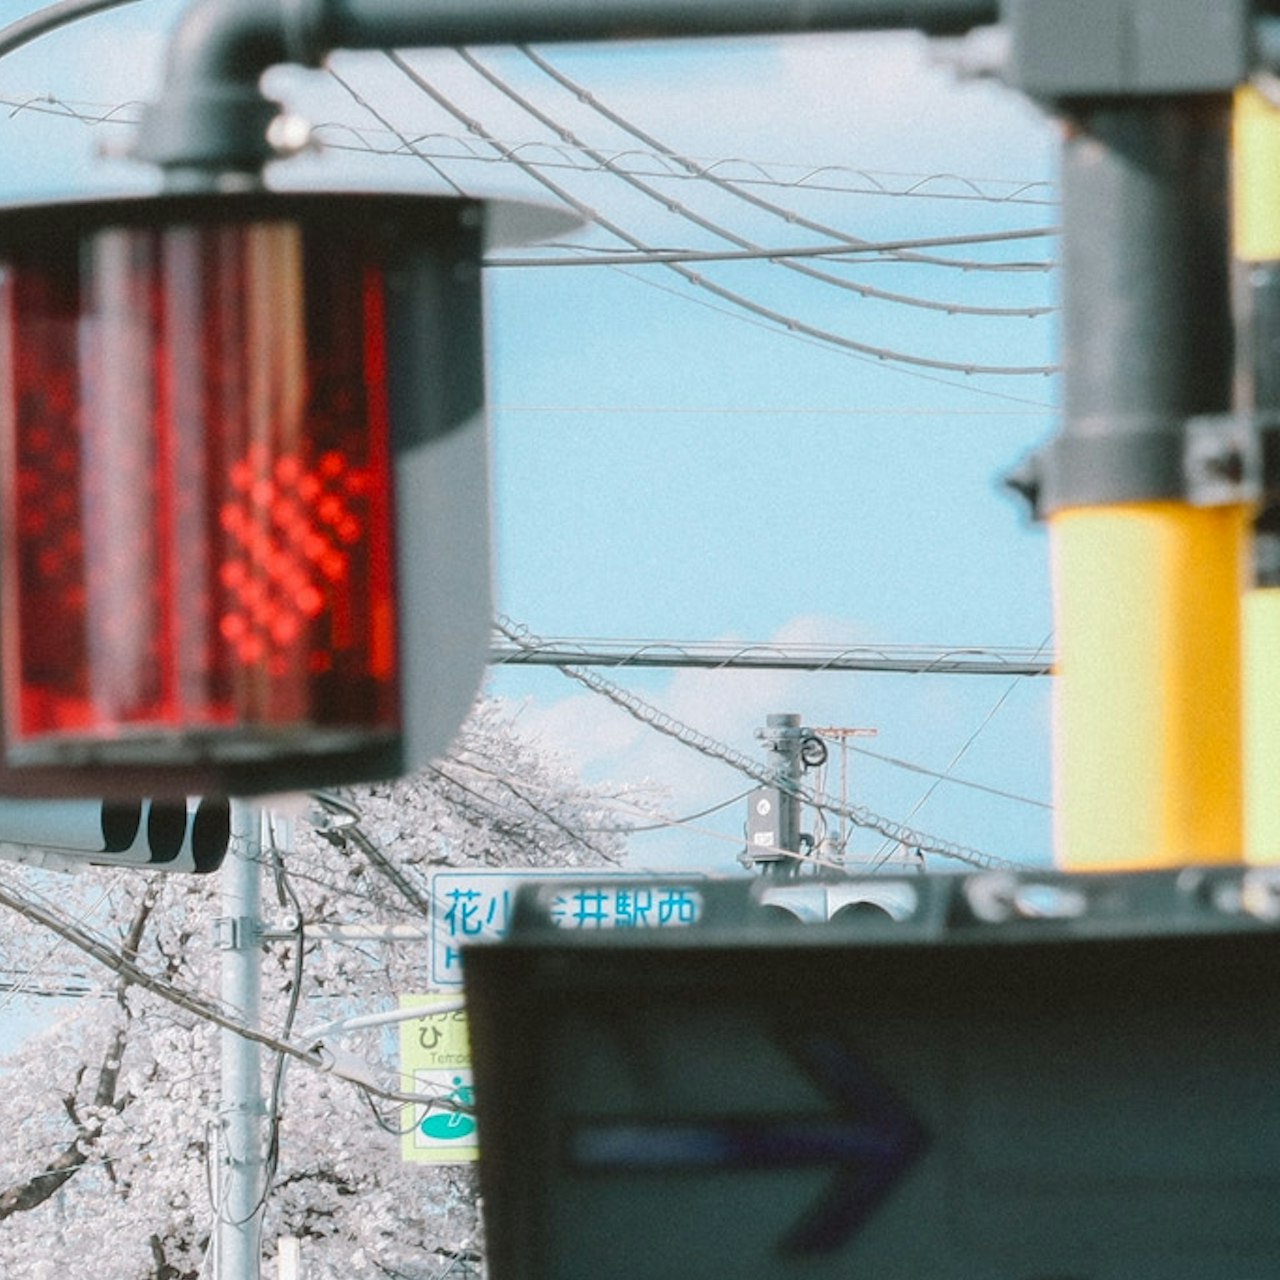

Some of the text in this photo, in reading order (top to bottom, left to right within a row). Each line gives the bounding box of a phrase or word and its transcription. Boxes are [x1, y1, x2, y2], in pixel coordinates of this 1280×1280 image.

[444, 886, 698, 938] 花小井駅西
